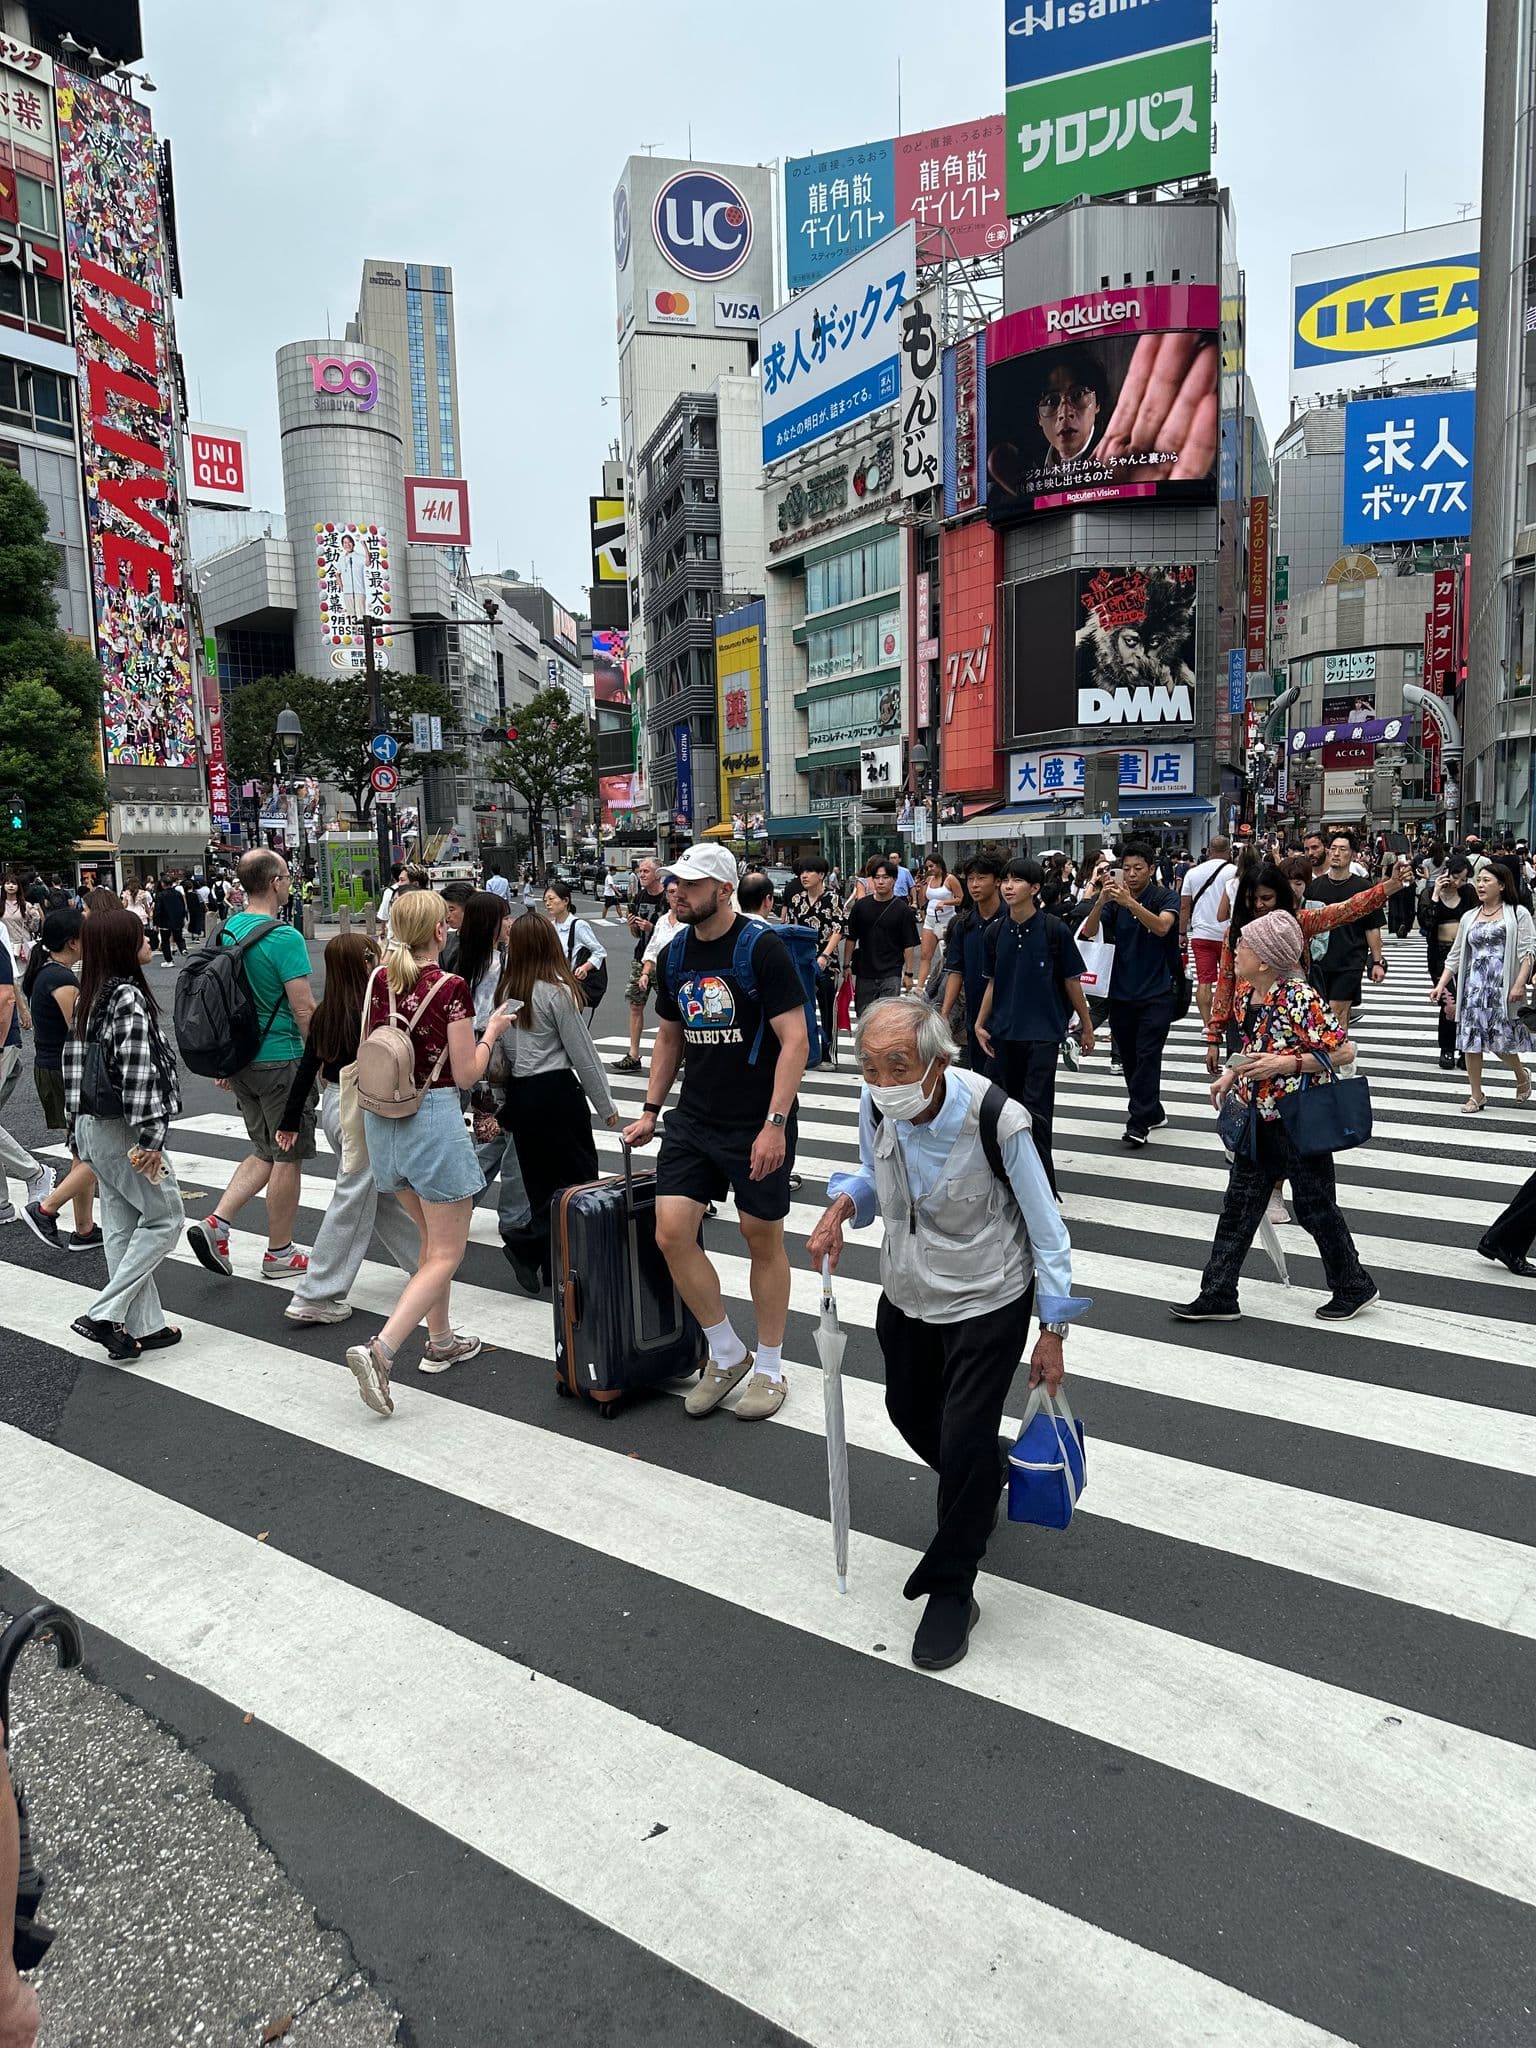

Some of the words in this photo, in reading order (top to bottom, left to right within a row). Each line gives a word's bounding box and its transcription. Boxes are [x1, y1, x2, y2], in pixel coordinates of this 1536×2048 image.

[1018, 85, 1197, 172] サロンパス
[919, 149, 987, 192] 龍角散
[809, 172, 872, 215] 龍角散
[911, 186, 1000, 227] ダイレクト
[800, 208, 885, 249] ダイレクト
[656, 315, 690, 323] mastercard
[717, 302, 761, 320] VISA
[1047, 300, 1141, 332] Rakuten
[1317, 279, 1480, 338] IKEA
[764, 271, 907, 395] 求人ボックス
[306, 354, 378, 411] 109
[903, 300, 937, 481] もんじゃ
[313, 398, 355, 411] SHIBUYA
[776, 388, 873, 446] あなたの明日が、詰まってる。
[197, 441, 234, 465] UNI
[1363, 417, 1469, 475] 求人
[199, 464, 238, 486] QLO
[1066, 491, 1096, 502] Rakuten
[1097, 488, 1120, 497] Vision
[421, 500, 453, 522] H&M
[1361, 481, 1468, 521] ボックス
[1253, 502, 1265, 597] クスリのことなら
[323, 532, 344, 615] 運動会開幕
[366, 535, 385, 617] 世界最大の
[1249, 605, 1265, 663] 三千里
[1436, 582, 1453, 660] カラオケ
[945, 624, 992, 725] クスリ
[1326, 667, 1375, 682] クリニック
[1338, 655, 1375, 669] れいわ
[726, 689, 748, 731] 薬
[1078, 685, 1193, 725] DMM
[212, 727, 223, 751] アコム
[210, 762, 229, 813] スギ薬局
[683, 1028, 744, 1045] SHIBUYA
